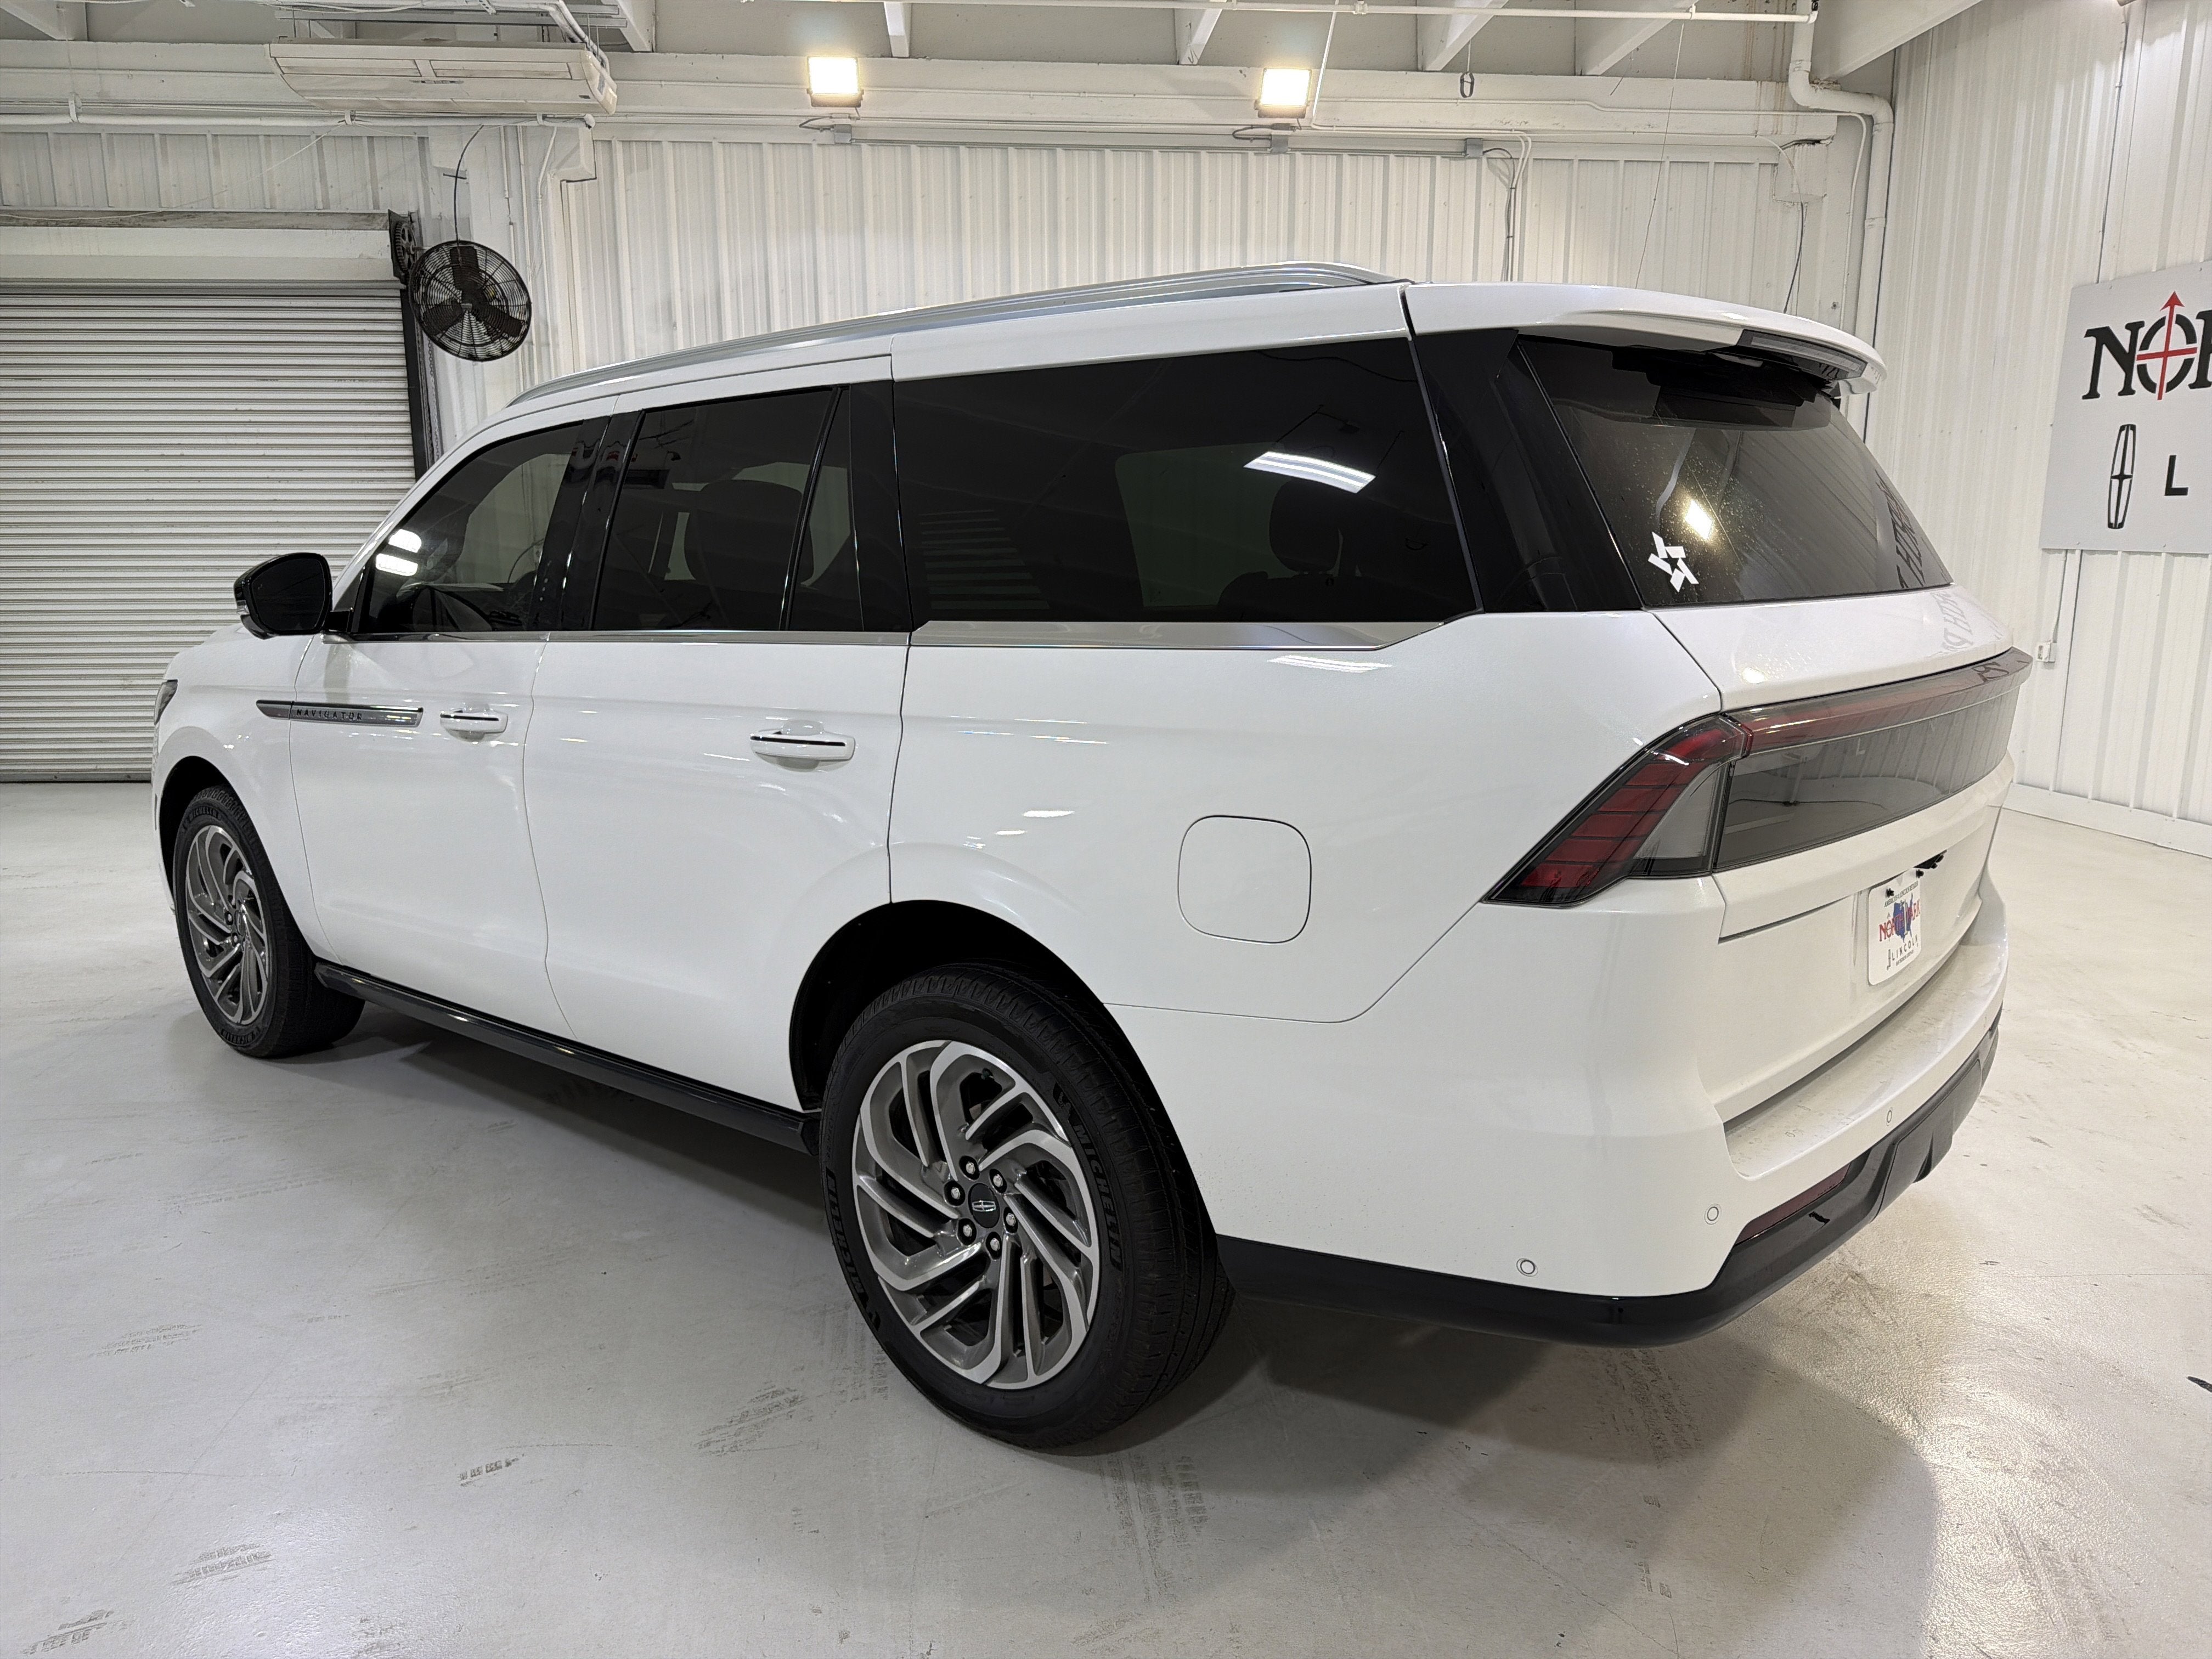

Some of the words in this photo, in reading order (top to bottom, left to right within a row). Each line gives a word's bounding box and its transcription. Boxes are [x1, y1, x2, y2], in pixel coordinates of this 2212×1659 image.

[296, 708, 363, 721] NAVIGATOR
[1879, 911, 1905, 942] NORTH
[1906, 898, 1921, 924] PARK
[1892, 934, 1918, 961] LINCOLN
[1072, 1123, 1122, 1265] MICHELIN
[826, 1172, 866, 1295] MICHELIN
